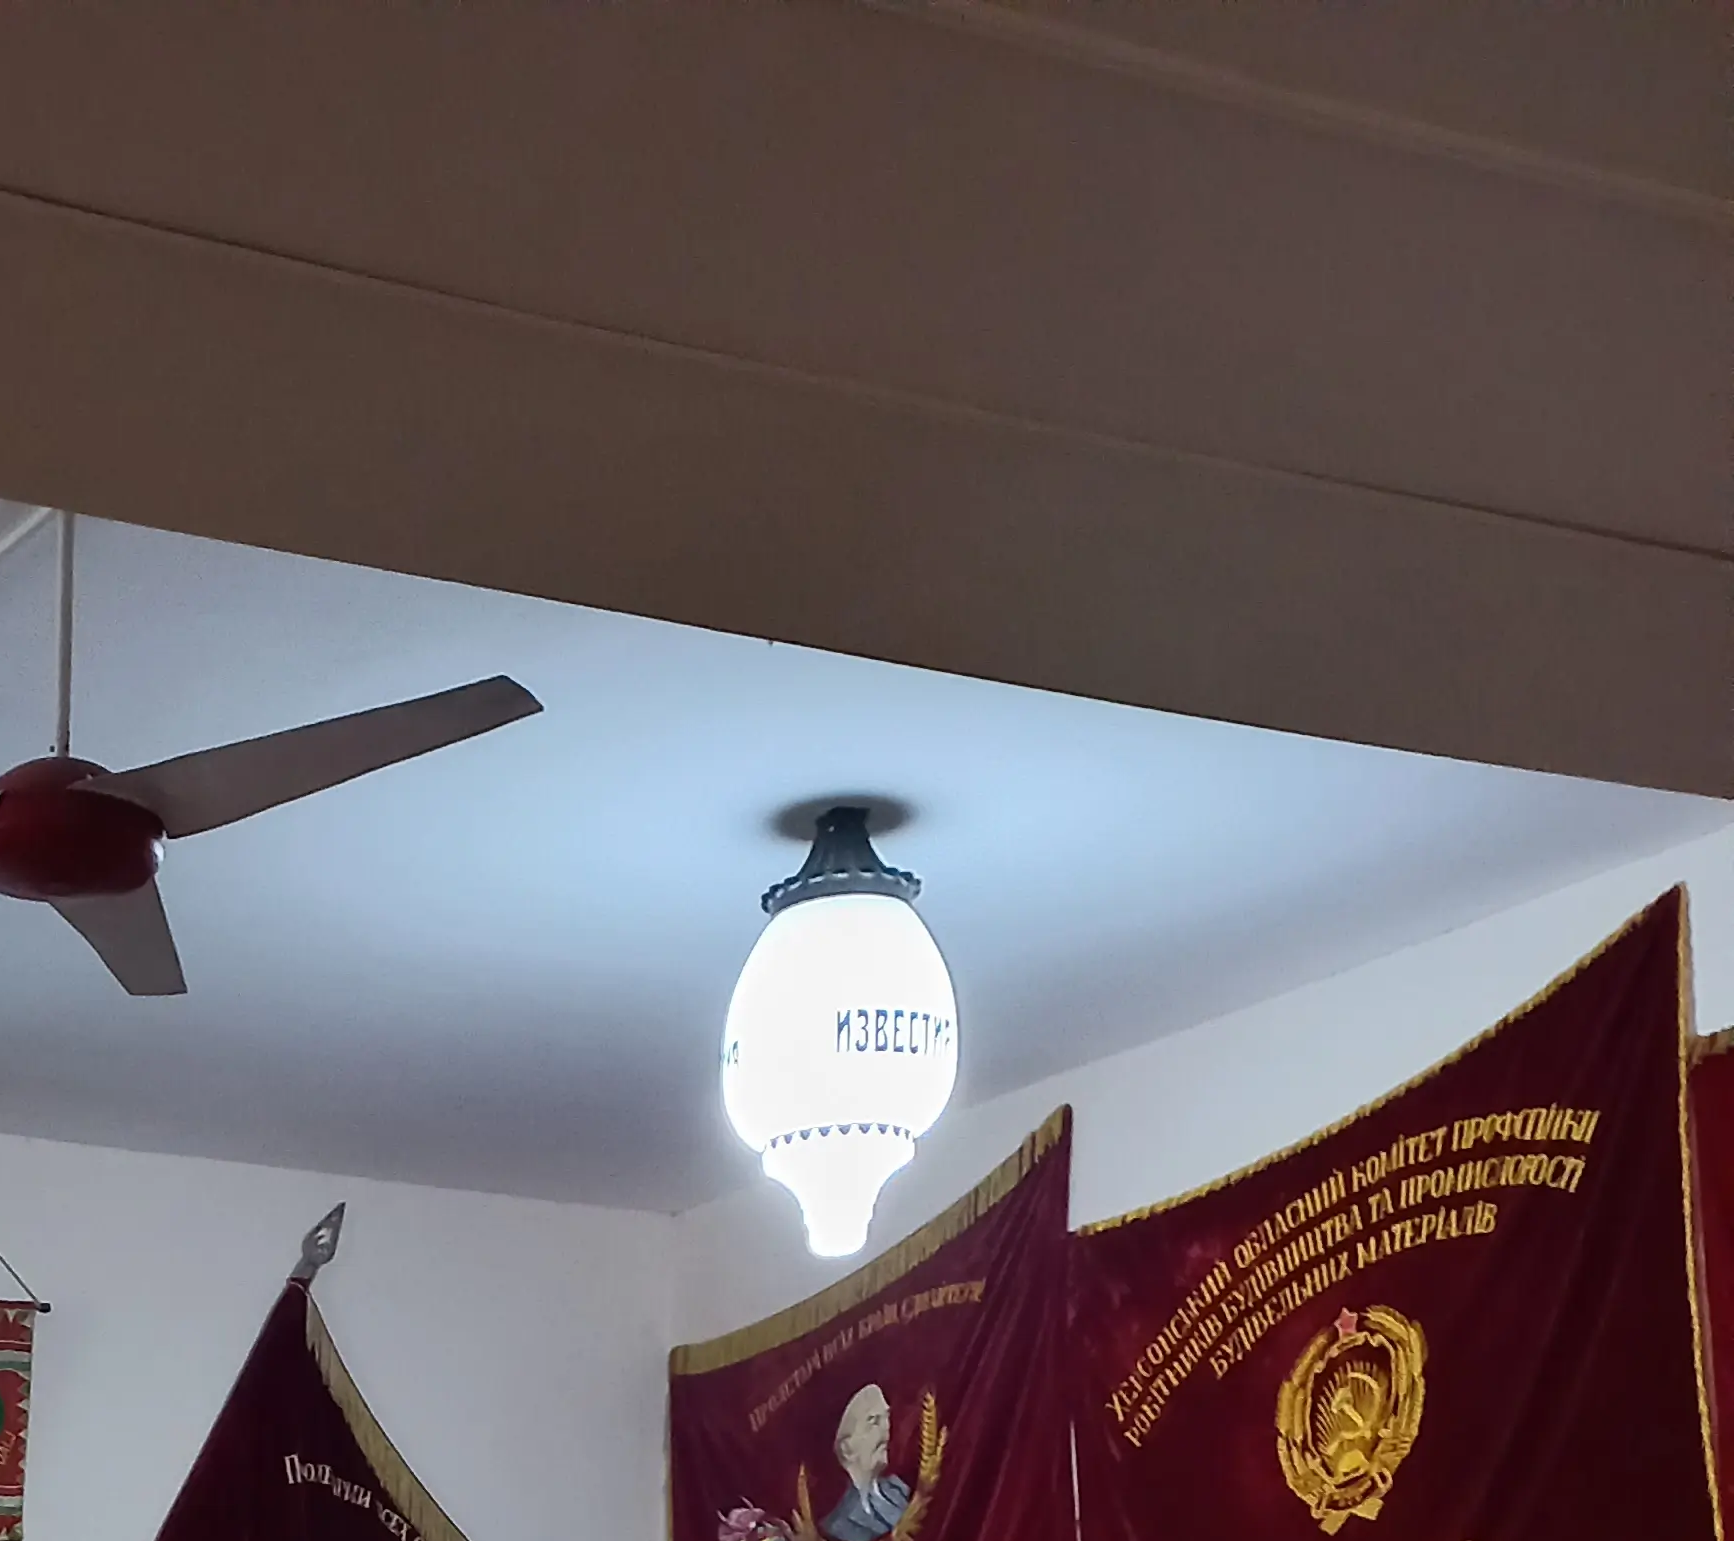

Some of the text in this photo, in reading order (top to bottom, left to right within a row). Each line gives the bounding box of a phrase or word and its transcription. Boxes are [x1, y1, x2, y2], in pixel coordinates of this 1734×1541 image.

[1351, 1125, 1449, 1193] КОМІТЕТ
[1356, 1200, 1499, 1270] МАТЕРІАЛІВ
[1368, 1187, 1395, 1223] ТА
